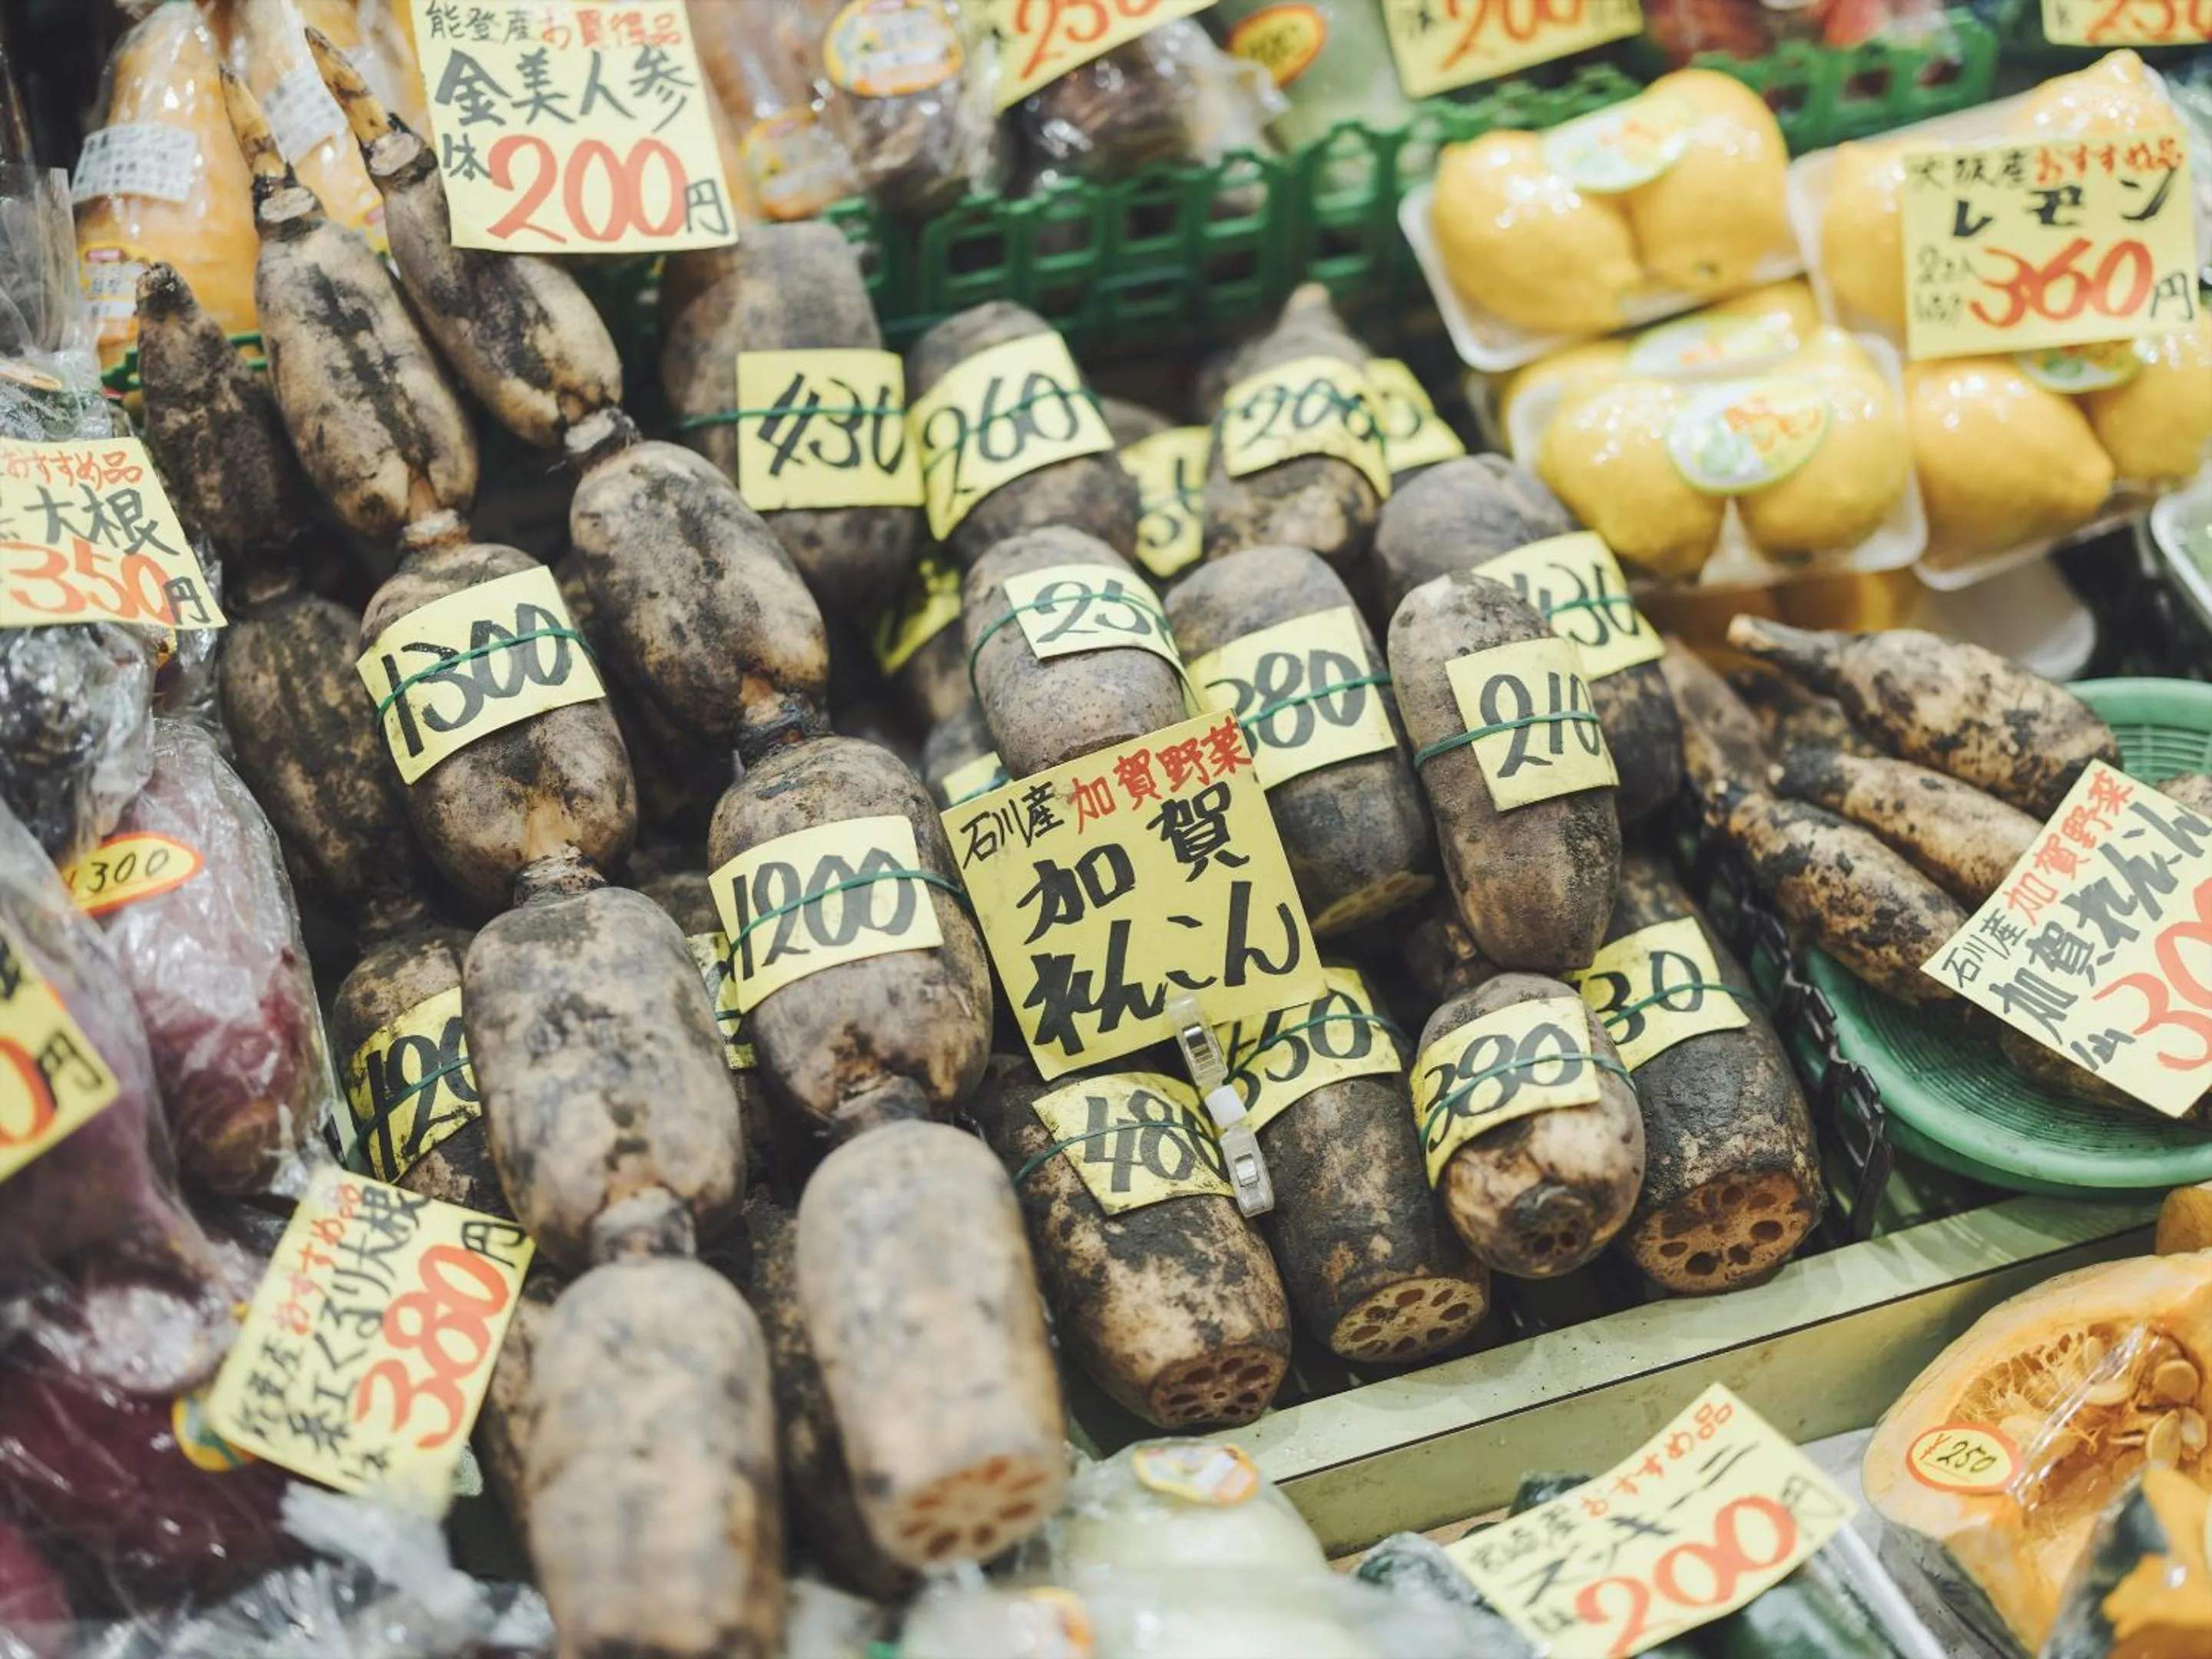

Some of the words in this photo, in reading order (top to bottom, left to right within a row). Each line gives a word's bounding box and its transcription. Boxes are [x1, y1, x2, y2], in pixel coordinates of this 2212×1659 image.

[426, 5, 531, 44] 能登産
[434, 45, 696, 134] 金美人参
[1951, 164, 2178, 237] レモン
[1969, 237, 2195, 329] 360円
[381, 603, 573, 758] 1300
[960, 780, 1065, 869] 石川産
[1070, 716, 1253, 835] 加賀野菜
[1016, 781, 1250, 945] 加賀
[732, 846, 917, 982] 1200
[1941, 908, 2028, 988] 石川産
[2002, 768, 2134, 927] 加賀野菜
[1988, 800, 2212, 1045] 加賀れんこん
[1022, 880, 1300, 1056] れんこん
[1424, 1022, 1584, 1154] 380
[353, 1220, 527, 1449] 380円
[1581, 1402, 1734, 1518] おすすめ品
